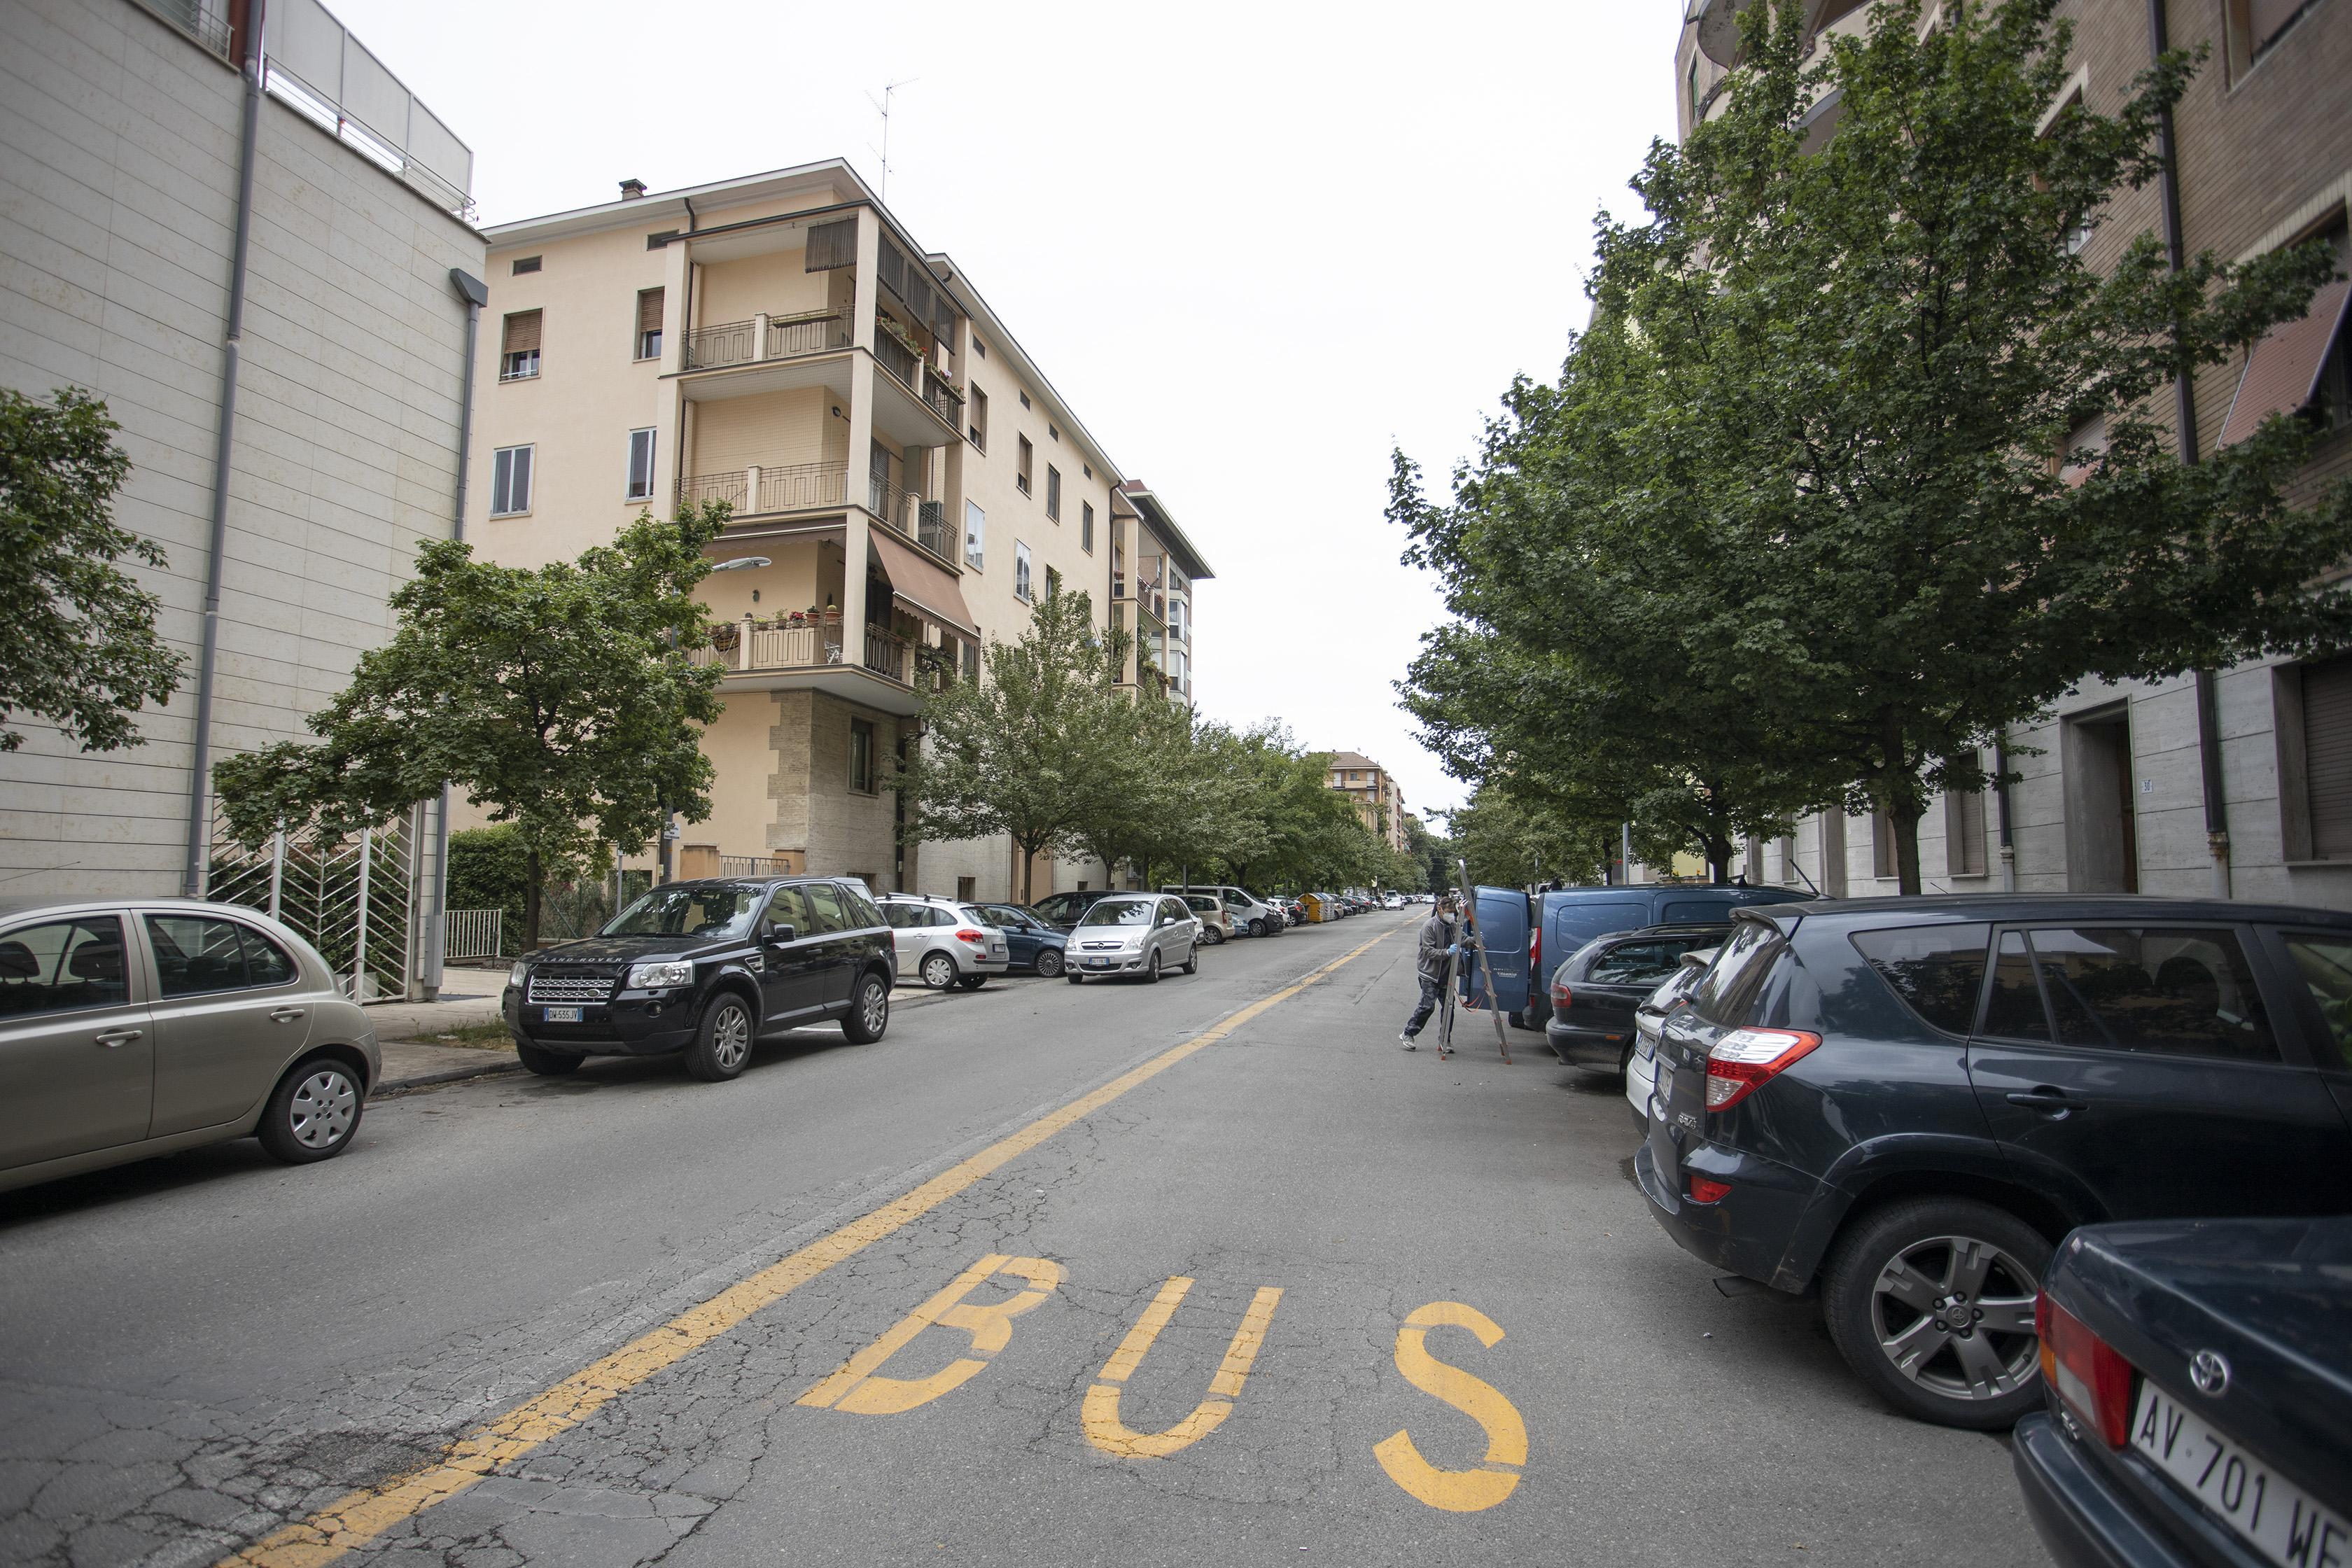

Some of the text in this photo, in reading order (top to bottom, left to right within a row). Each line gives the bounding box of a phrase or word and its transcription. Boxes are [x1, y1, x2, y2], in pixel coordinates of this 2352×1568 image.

[795, 1253, 1528, 1512] BUS
[2139, 1395, 2184, 1460] AV
[2195, 1434, 2266, 1533] 701
